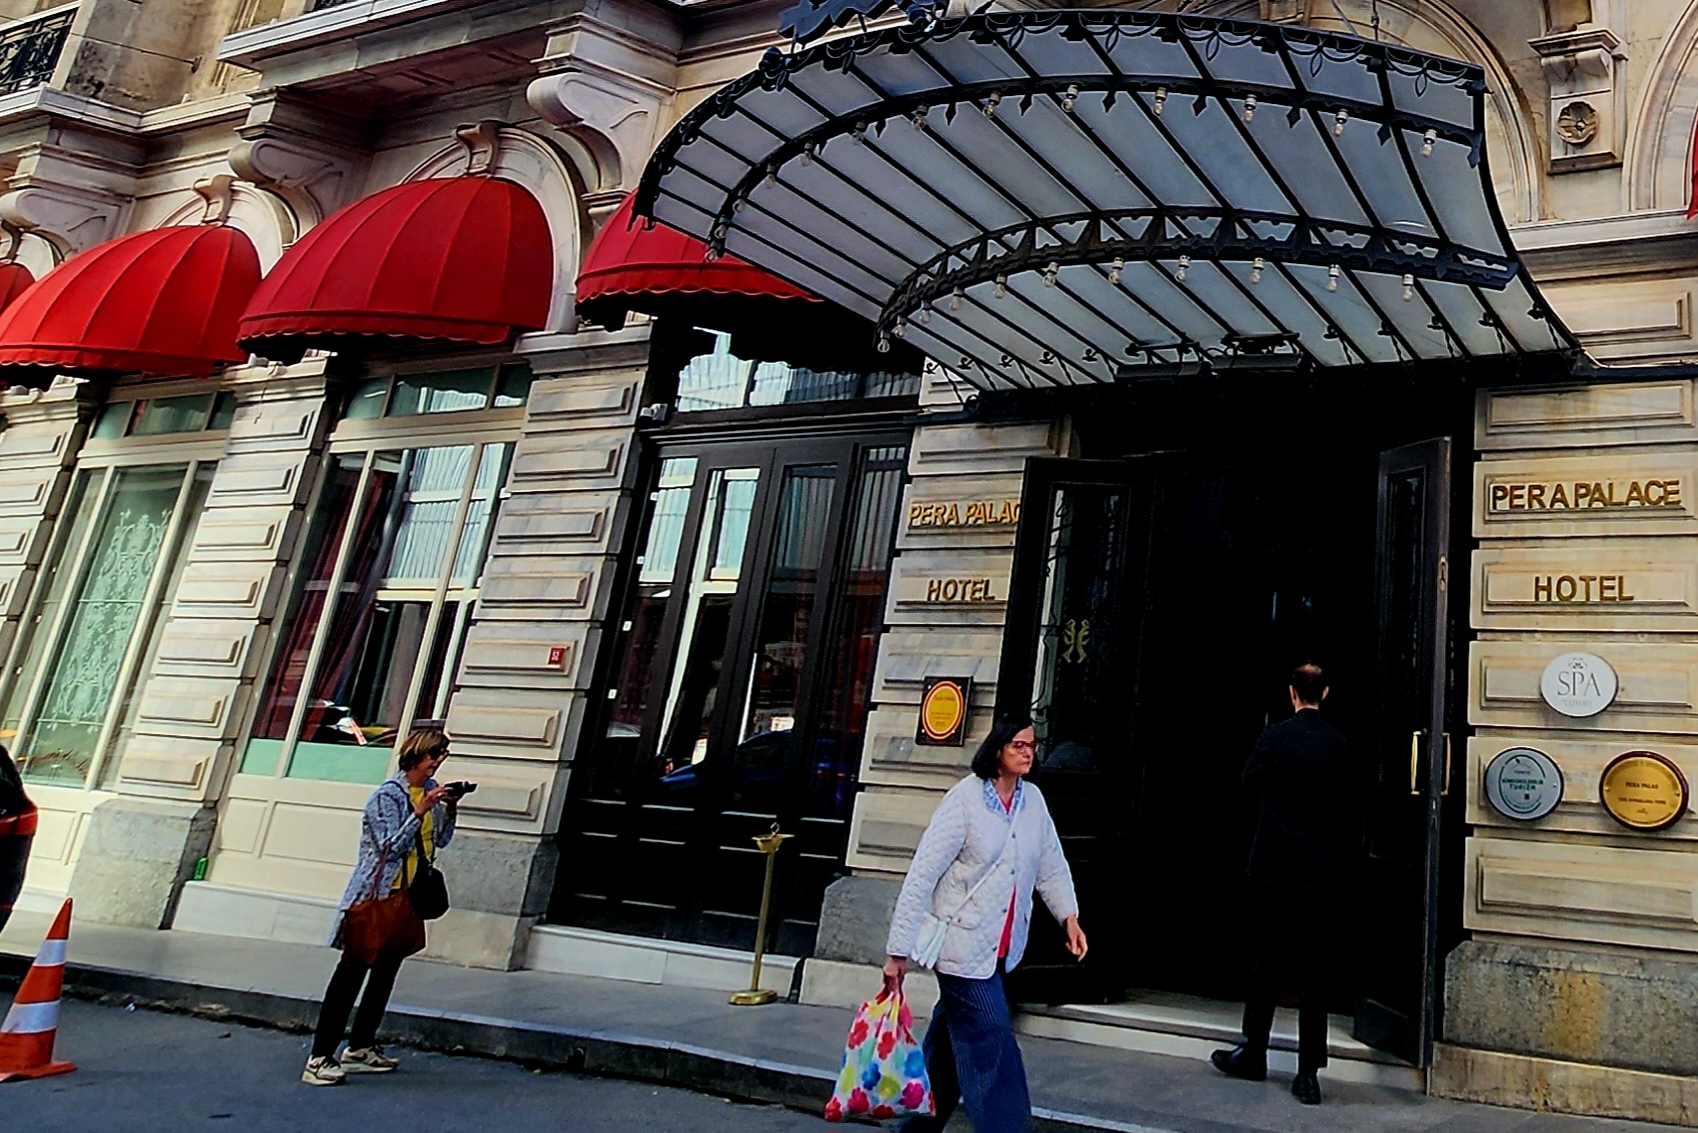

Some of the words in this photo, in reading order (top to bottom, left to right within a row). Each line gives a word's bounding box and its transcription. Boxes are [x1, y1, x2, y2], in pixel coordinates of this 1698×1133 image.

[909, 503, 960, 526] PERA
[927, 579, 995, 601] HOTEL
[1534, 575, 1634, 602] HOTEL
[1557, 671, 1601, 697] SPA
